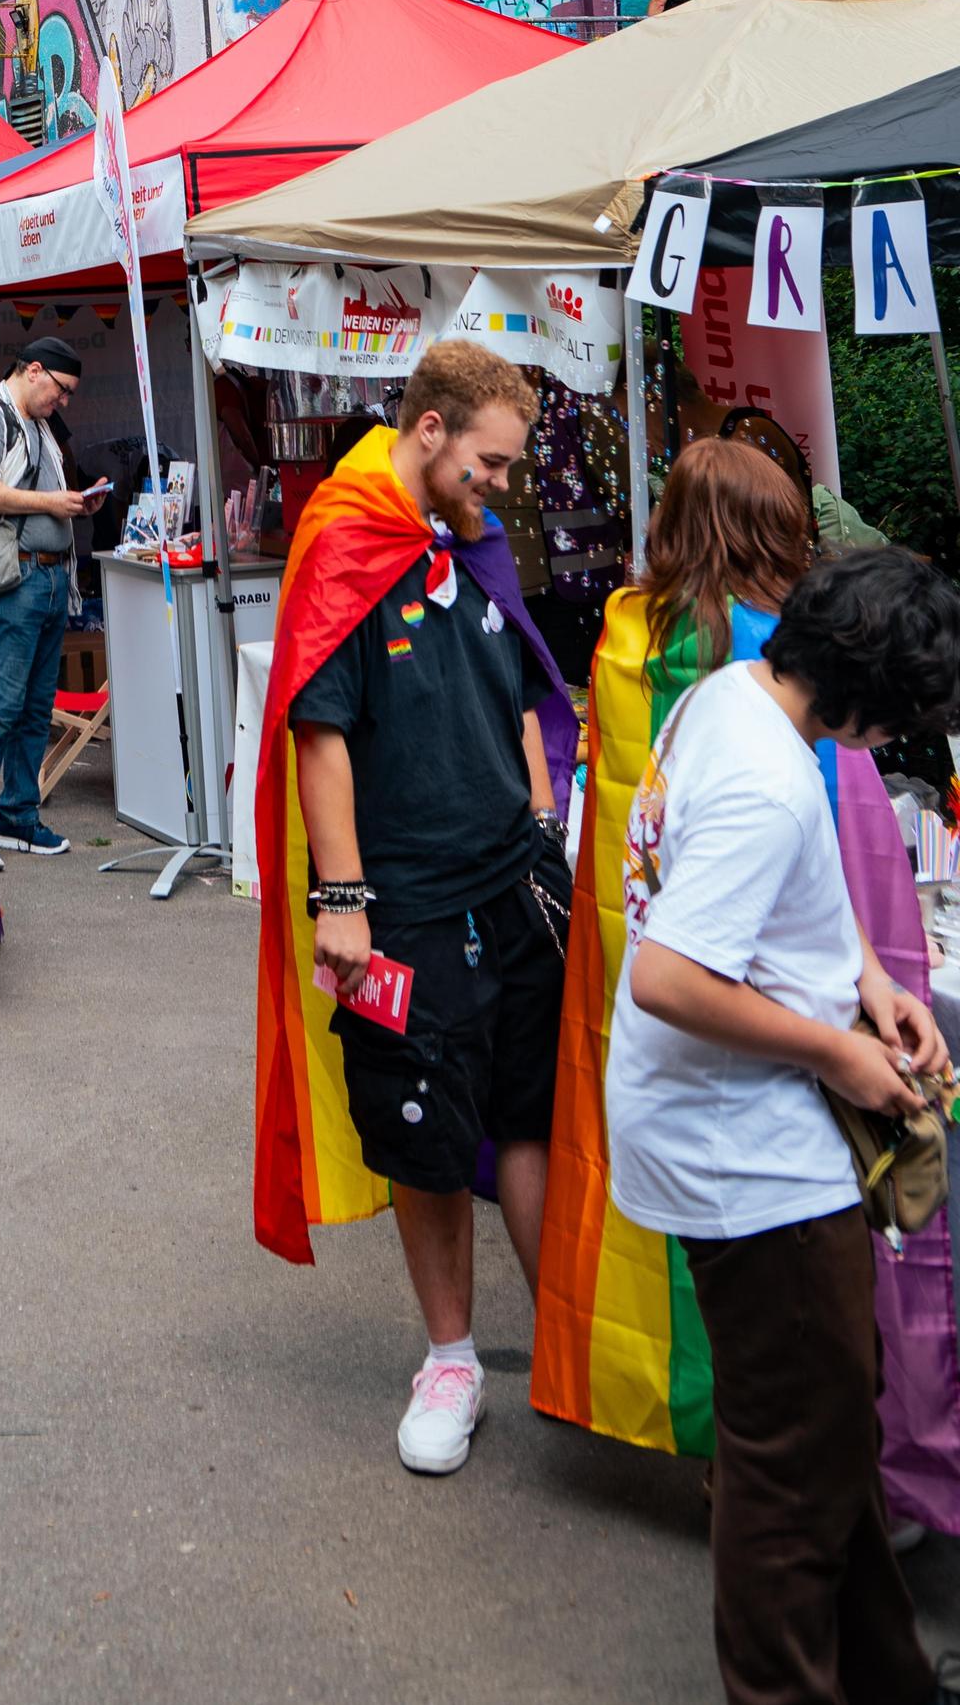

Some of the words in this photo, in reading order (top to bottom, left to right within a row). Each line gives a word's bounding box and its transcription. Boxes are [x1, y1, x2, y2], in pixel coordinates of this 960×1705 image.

[147, 181, 164, 200] und
[40, 209, 56, 228] und
[19, 232, 42, 248] Leben
[650, 203, 686, 298] G
[767, 214, 805, 321] R
[872, 210, 917, 321] A
[343, 314, 381, 331] WEIDEN
[382, 317, 398, 333] IST
